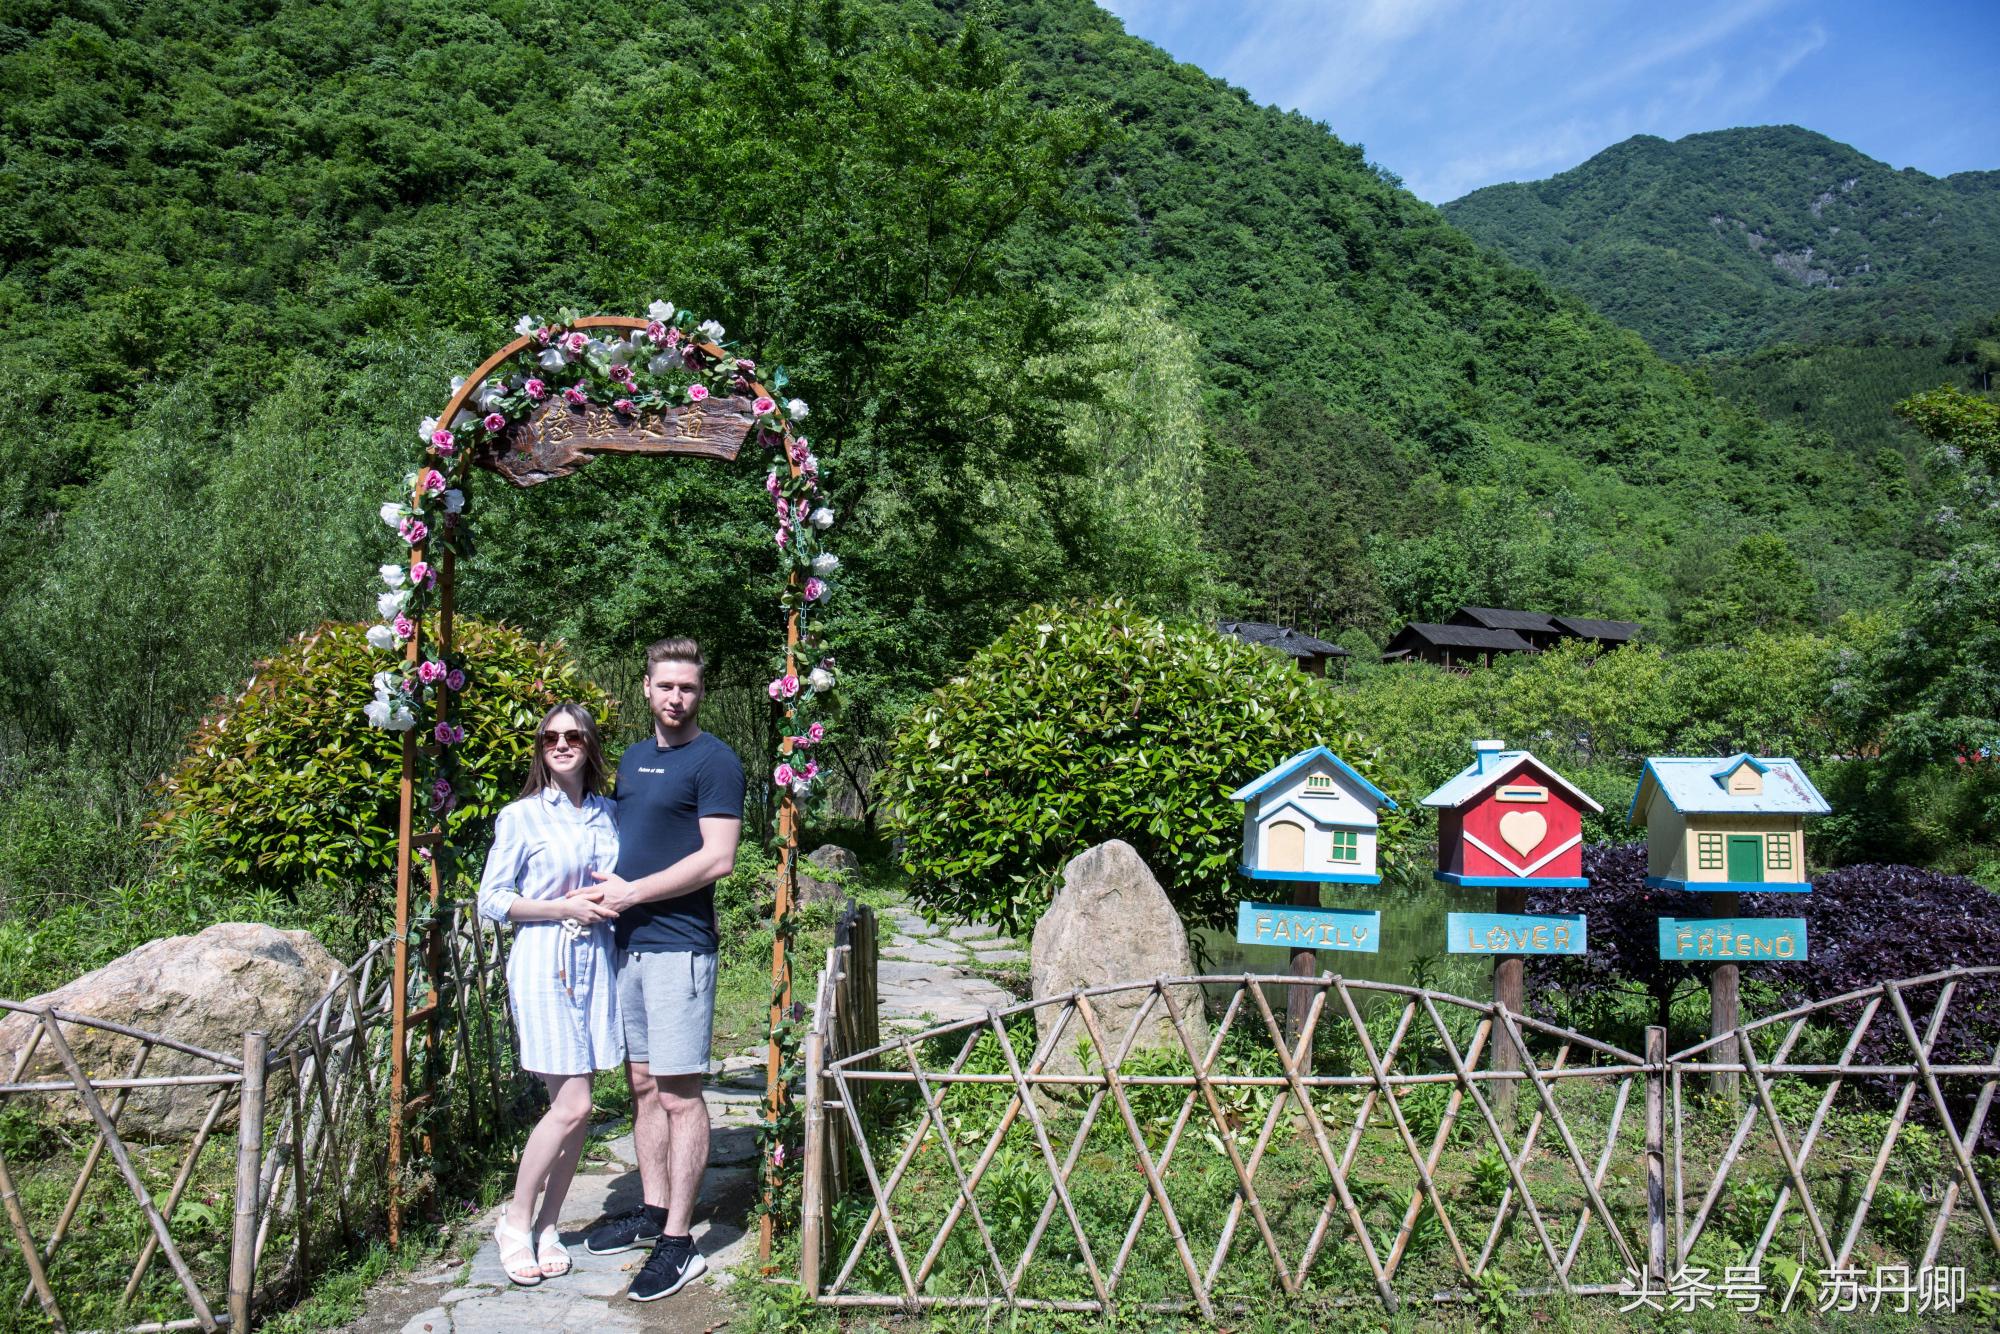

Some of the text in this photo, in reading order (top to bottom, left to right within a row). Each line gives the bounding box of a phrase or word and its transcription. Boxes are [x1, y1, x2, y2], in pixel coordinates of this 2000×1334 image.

[1255, 917, 1368, 949] FAMILY
[1468, 925, 1570, 951] LOVER
[1676, 933, 1795, 958] FRIEND
